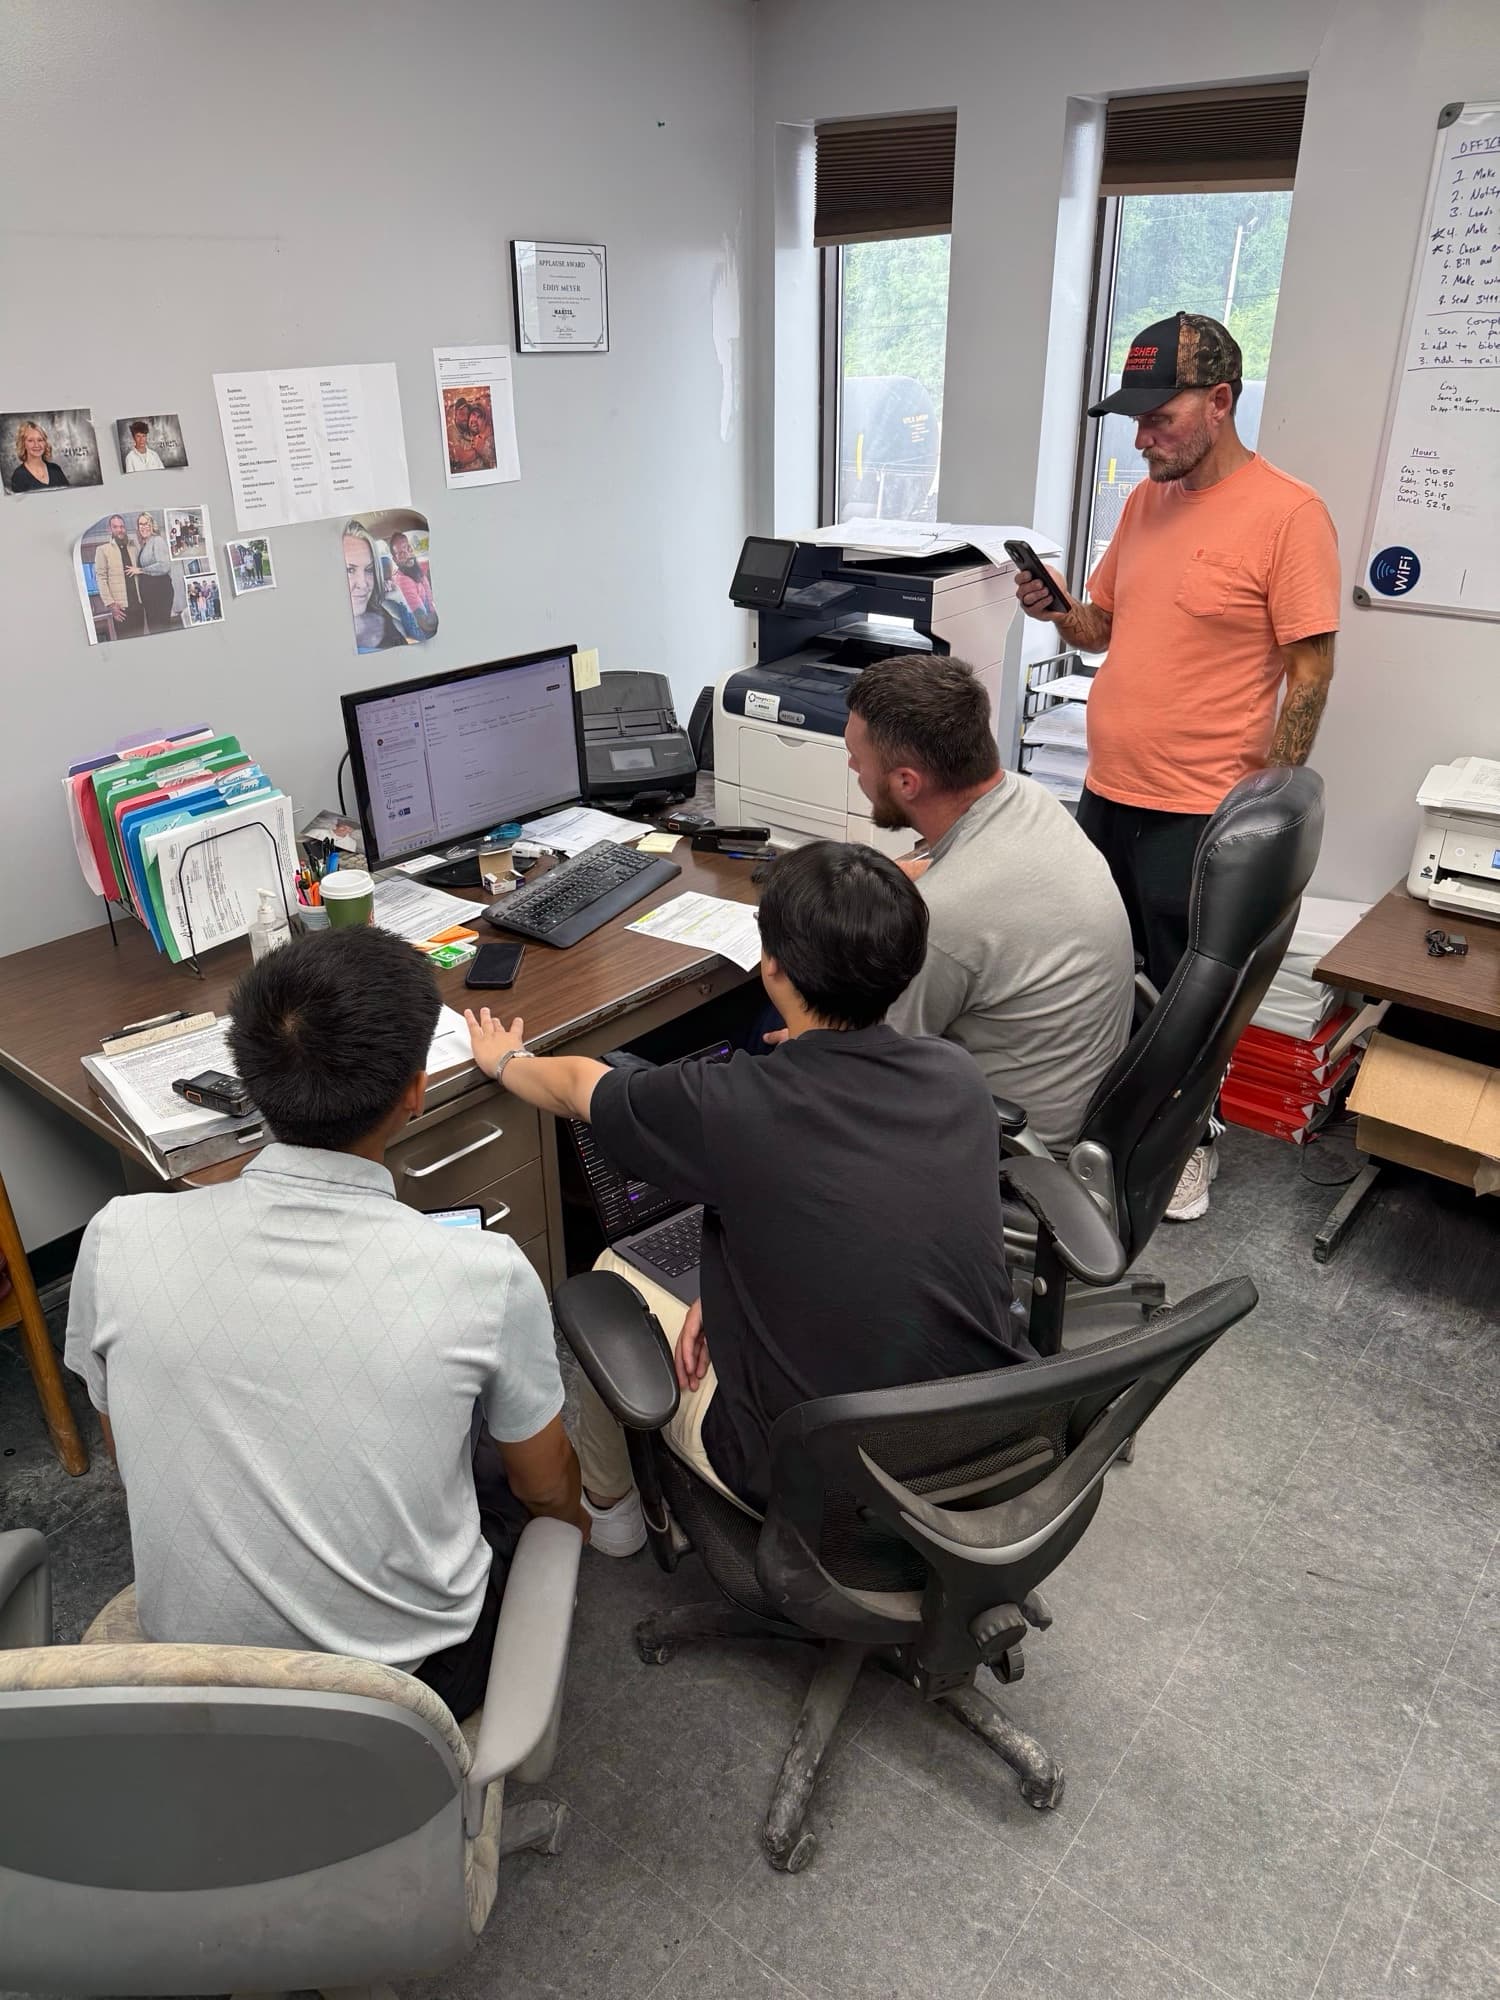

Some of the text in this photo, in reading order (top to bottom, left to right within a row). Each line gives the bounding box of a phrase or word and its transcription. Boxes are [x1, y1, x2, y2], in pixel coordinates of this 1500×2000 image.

[539, 260, 564, 268] APPLAUSE
[160, 440, 178, 448] 2025
[62, 446, 88, 456] 2025
[1412, 448, 1437, 456] Hours
[1394, 556, 1414, 590] WiFi
